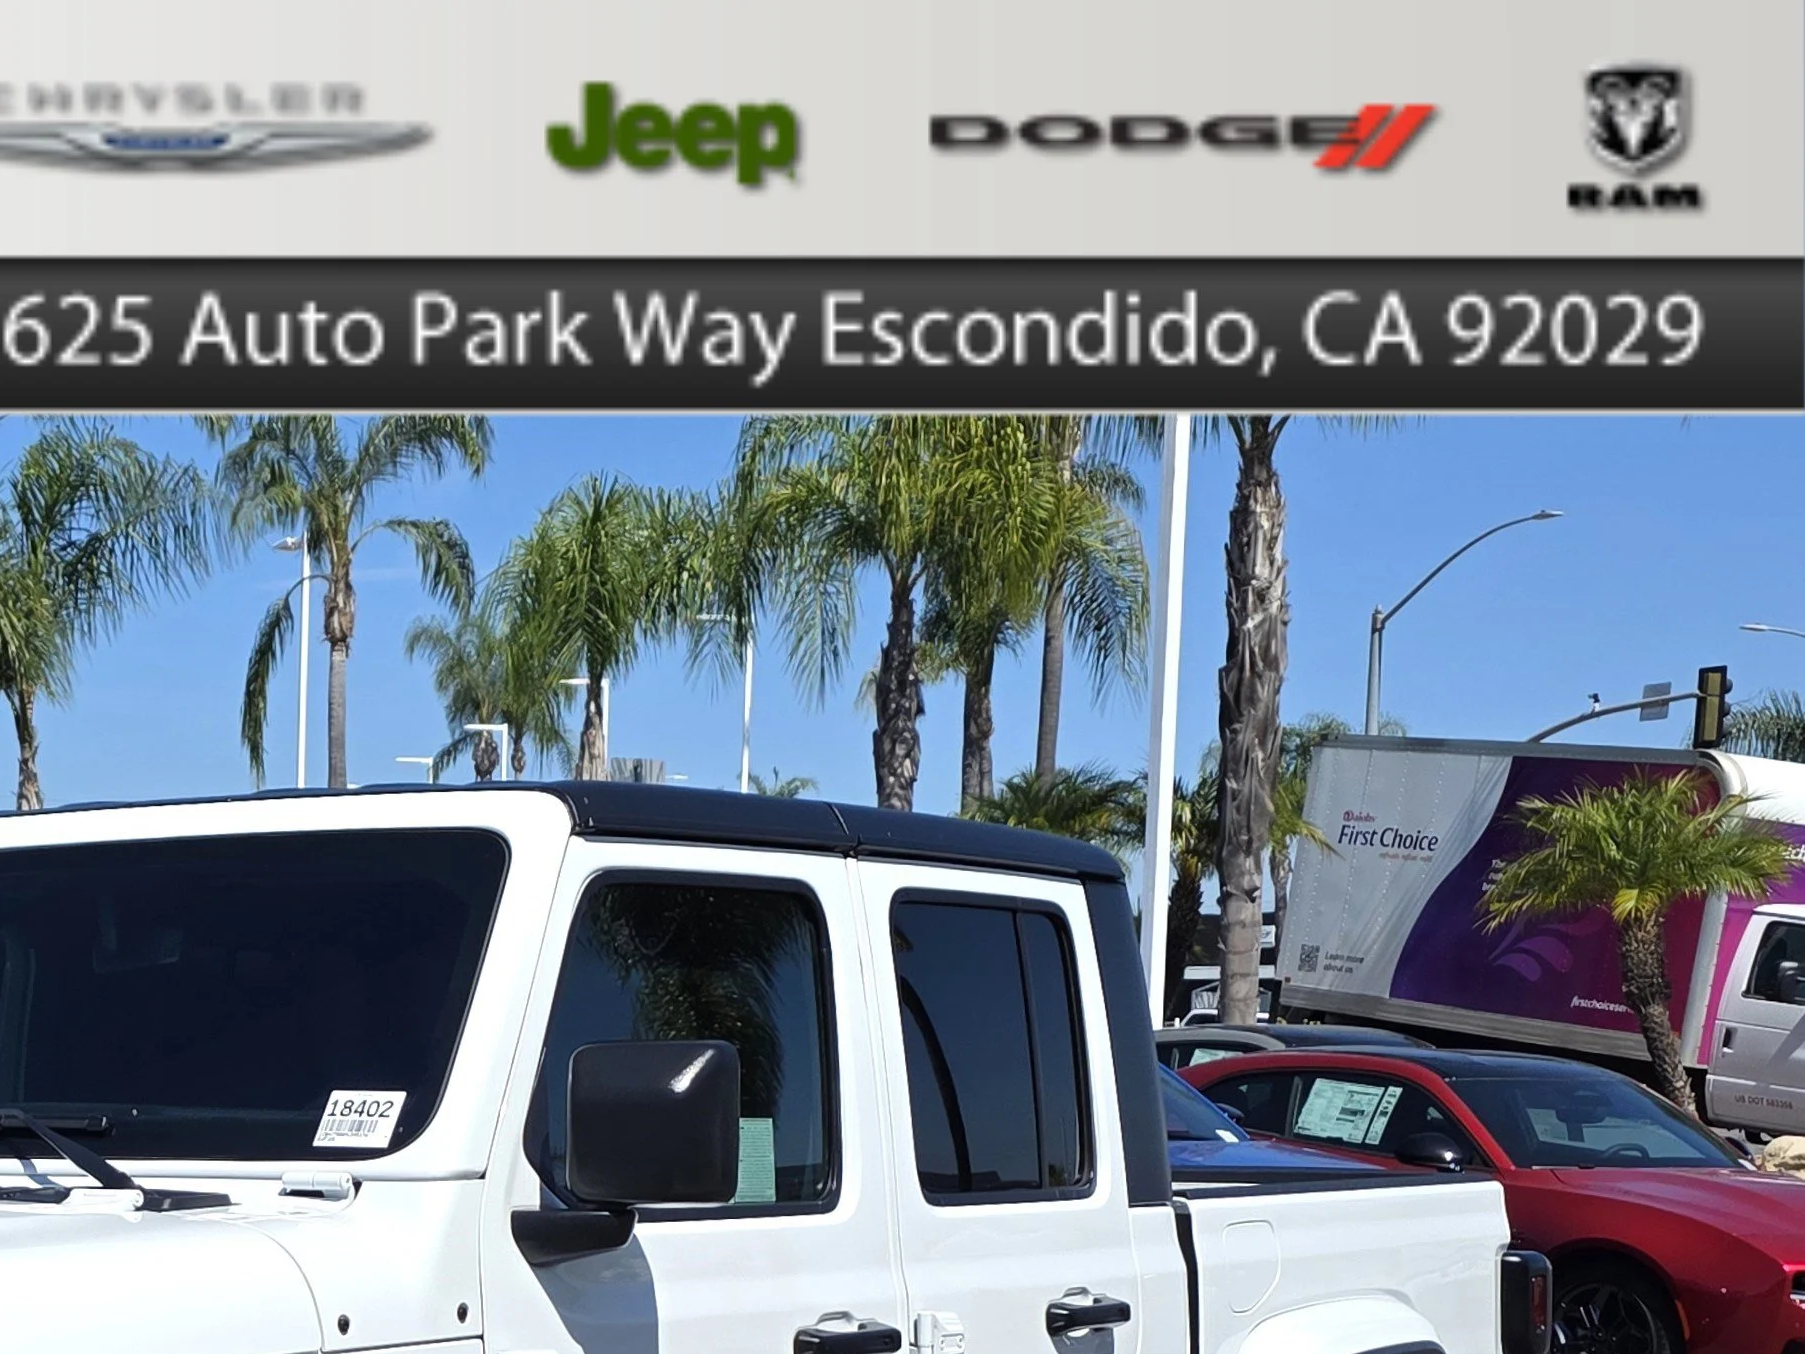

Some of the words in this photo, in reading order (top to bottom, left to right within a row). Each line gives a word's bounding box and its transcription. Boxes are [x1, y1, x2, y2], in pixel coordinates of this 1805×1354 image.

[1338, 824, 1378, 847] First
[1379, 827, 1439, 852] Choice
[326, 1099, 394, 1118] 18402
